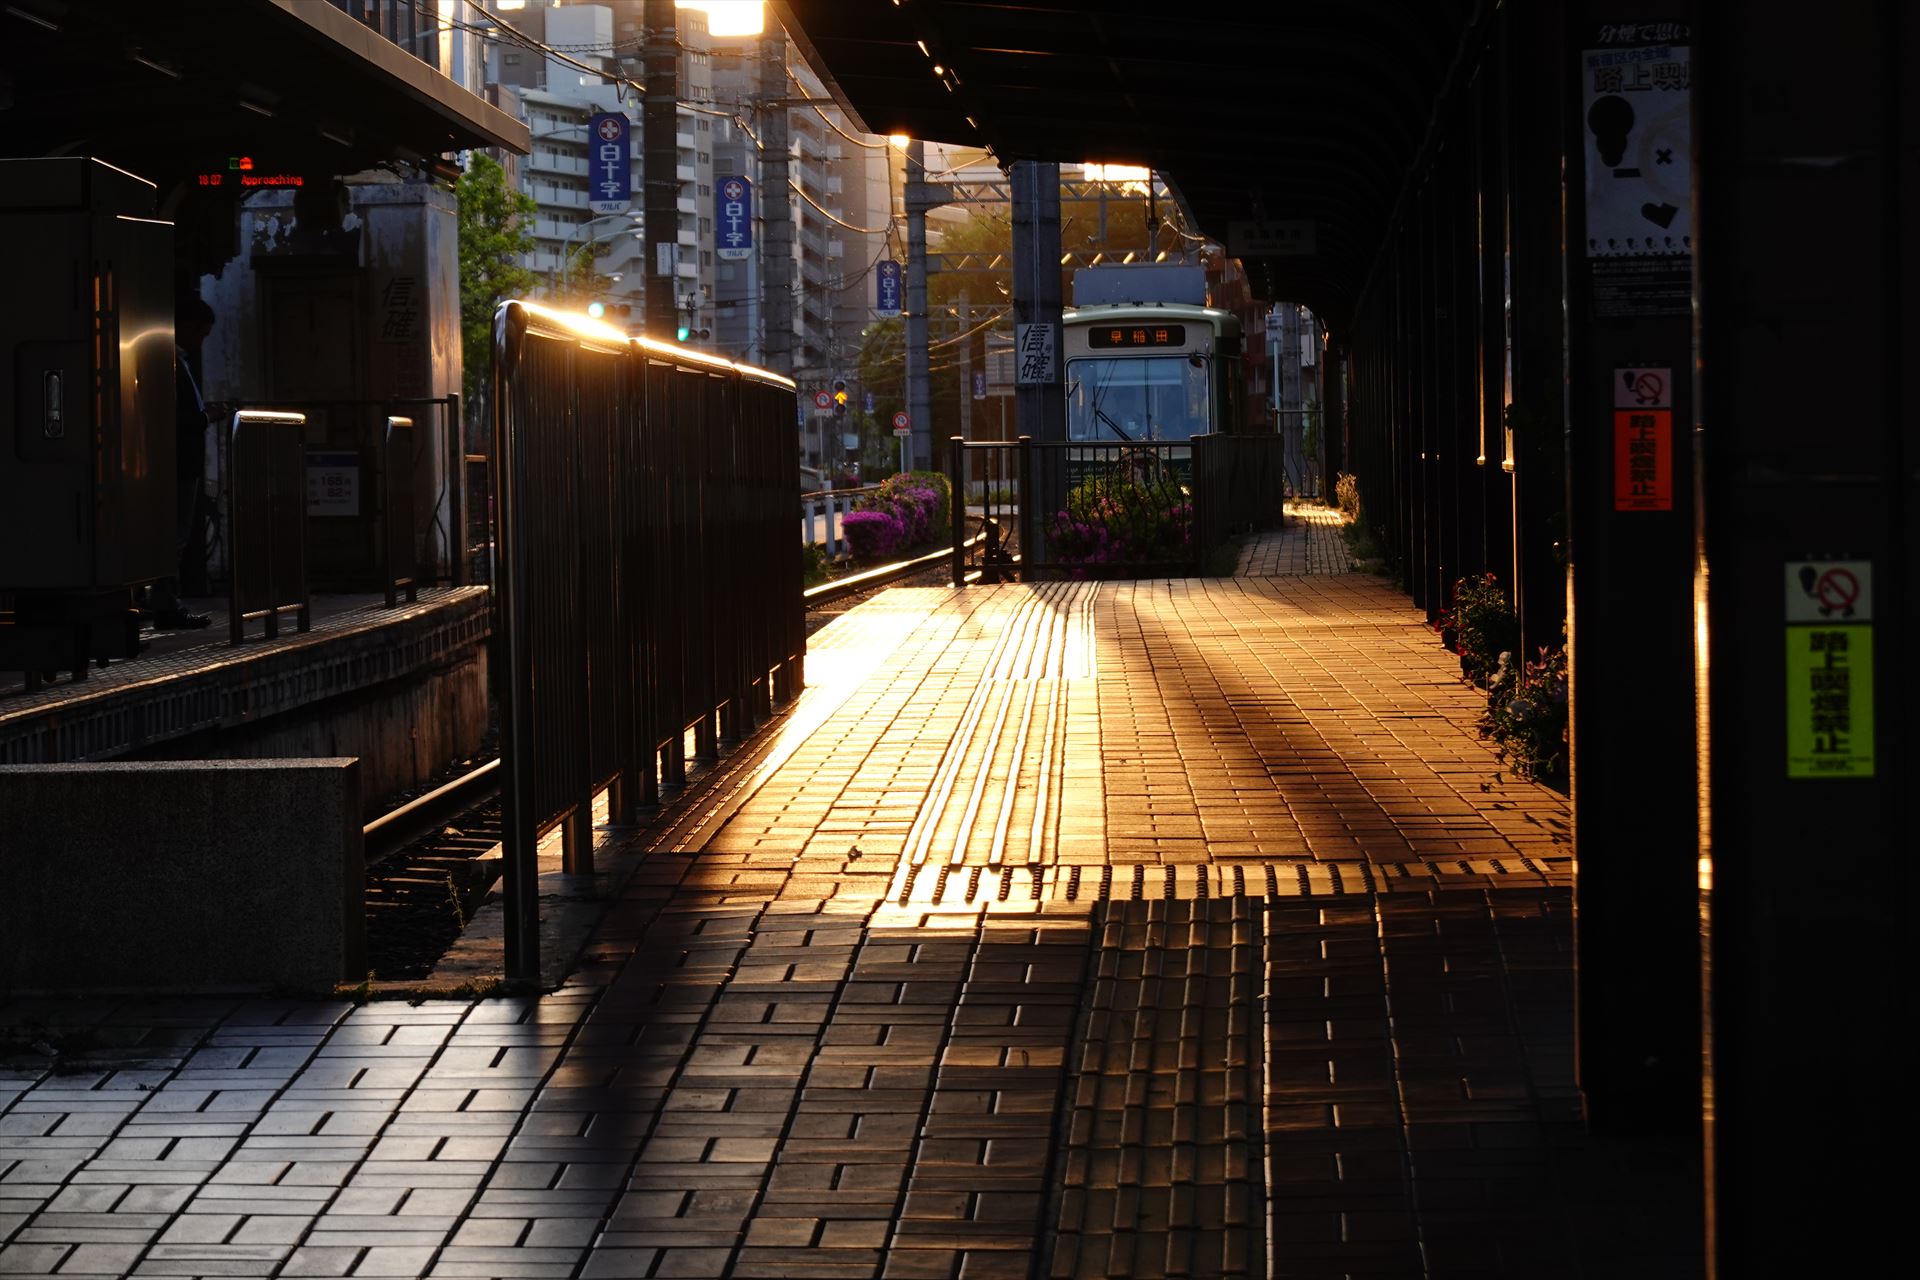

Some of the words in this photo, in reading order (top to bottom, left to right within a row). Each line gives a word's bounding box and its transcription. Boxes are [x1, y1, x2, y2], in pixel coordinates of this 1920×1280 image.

[241, 174, 304, 186] Approaching
[599, 143, 621, 198] 白十字
[725, 201, 743, 247] 白十字
[882, 277, 896, 309] 白十字
[1109, 329, 1169, 344] 早稲田
[1809, 631, 1852, 754] 路上喫煙禁止
